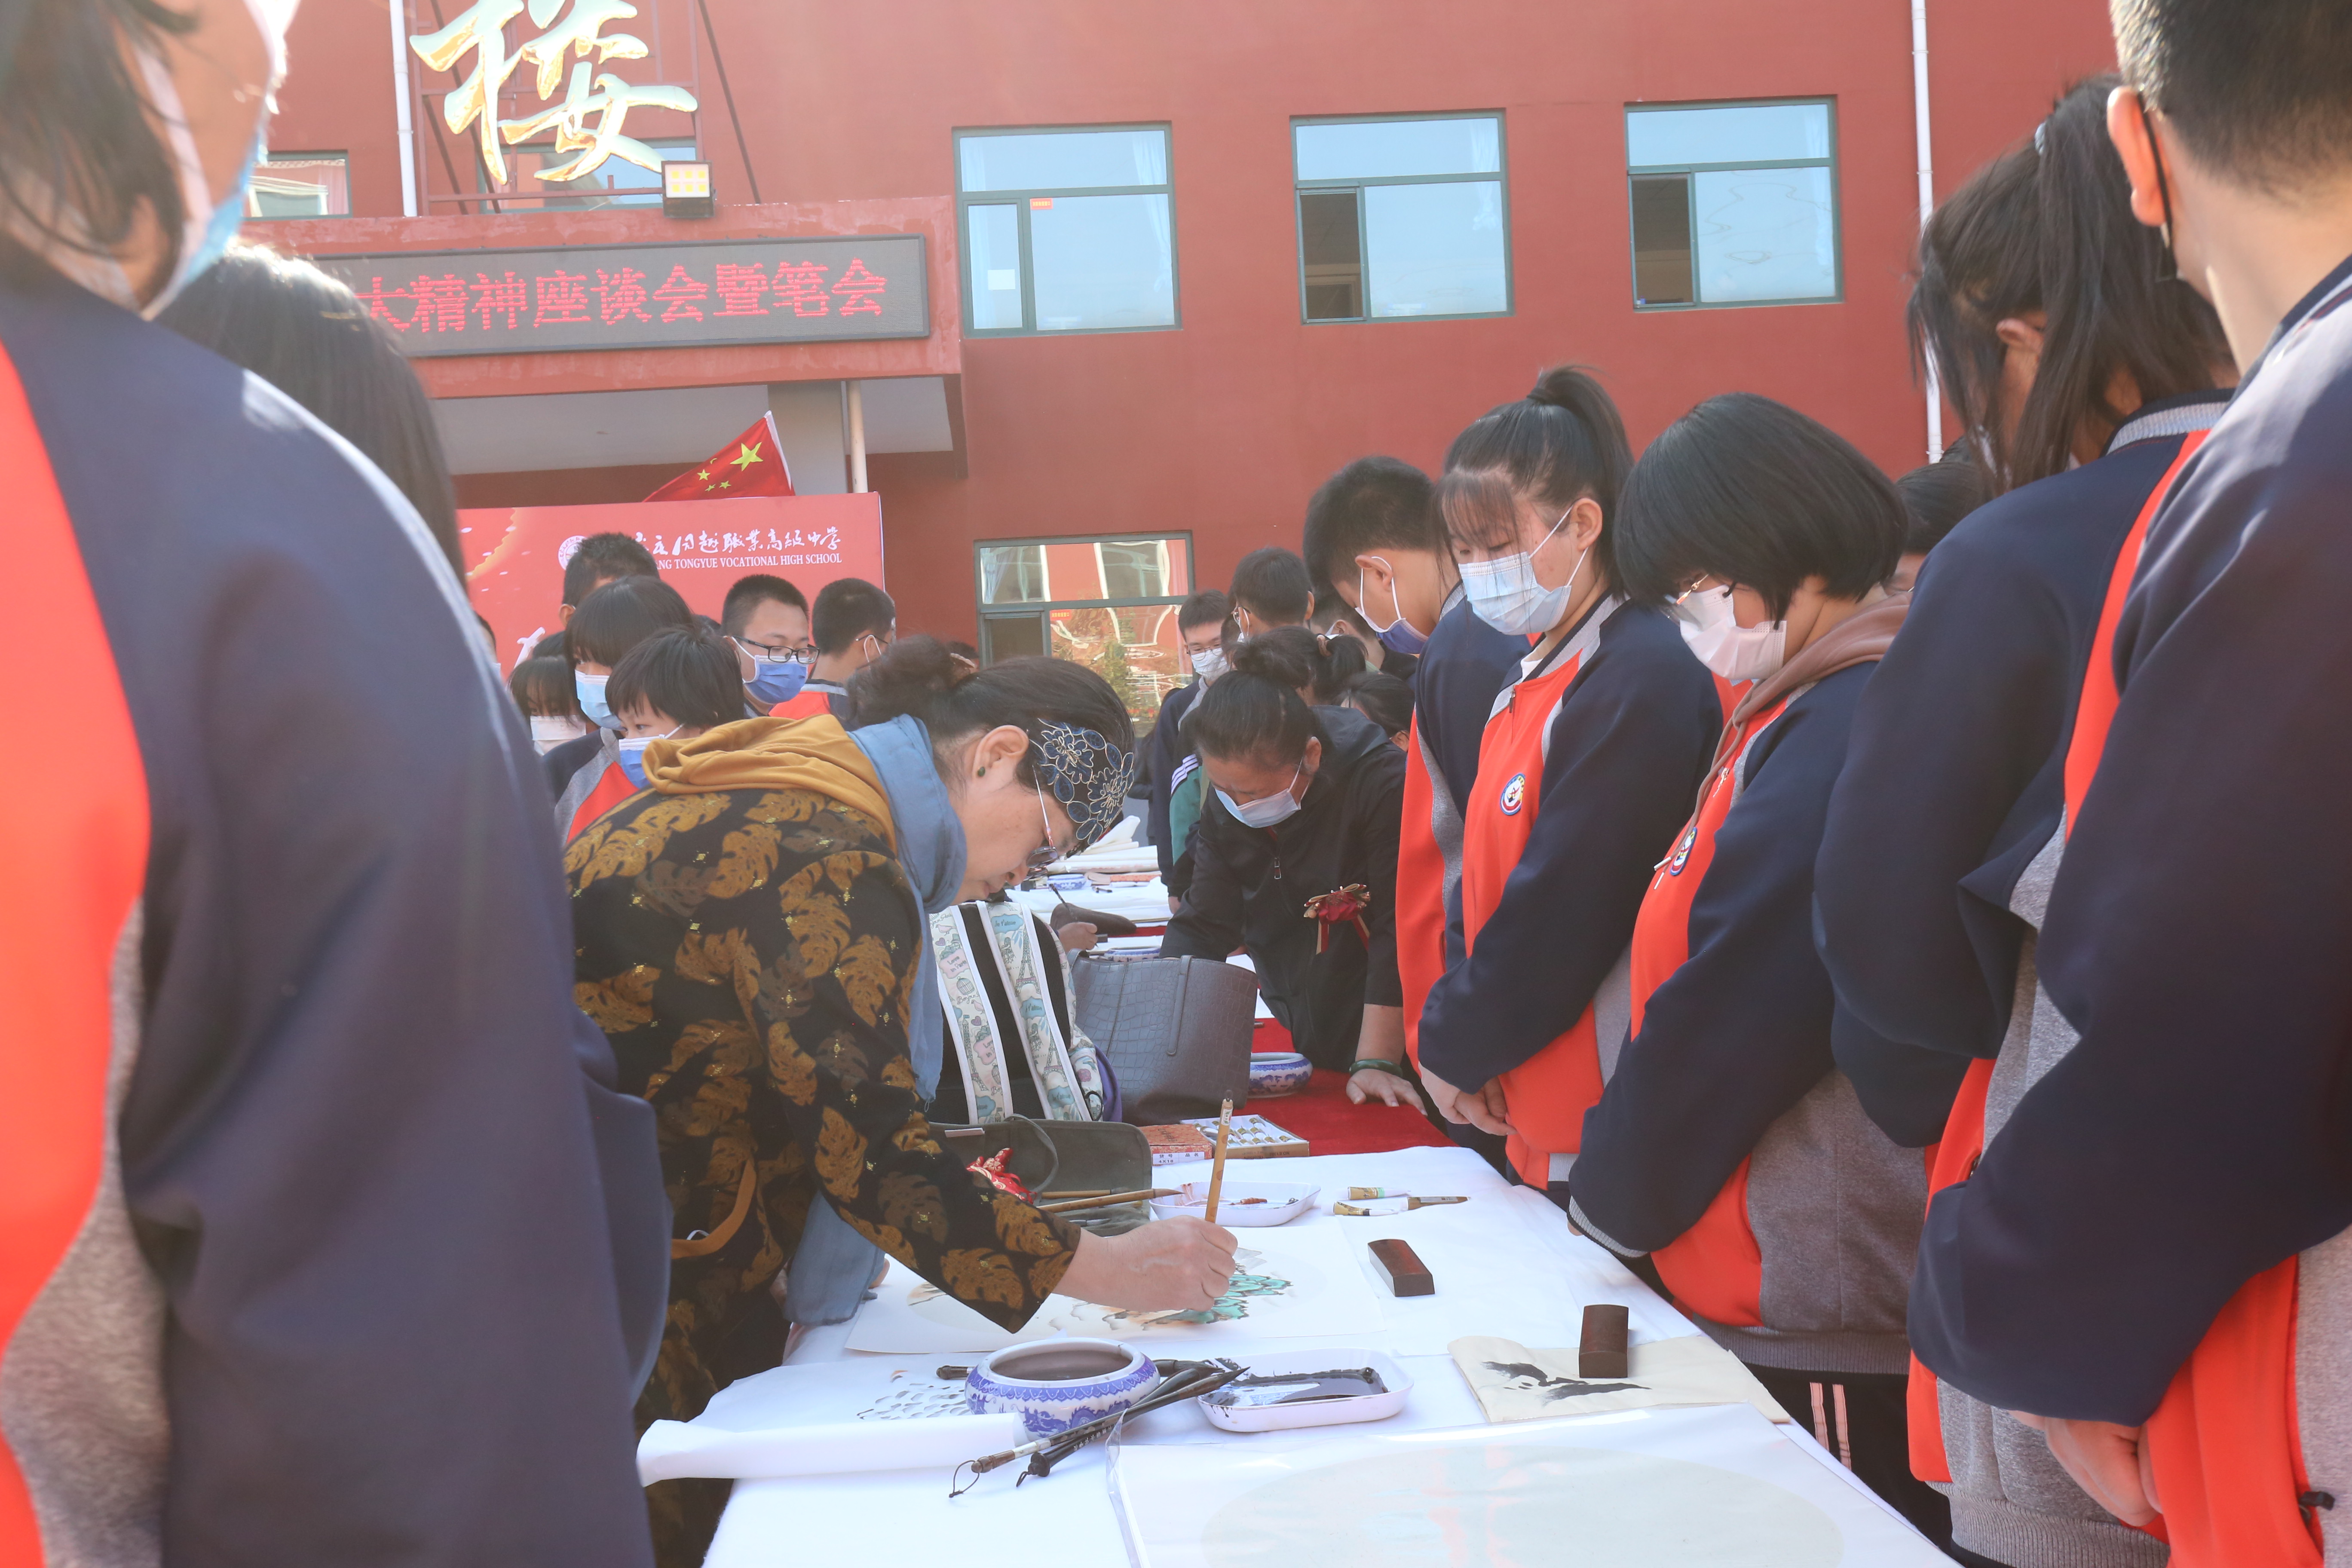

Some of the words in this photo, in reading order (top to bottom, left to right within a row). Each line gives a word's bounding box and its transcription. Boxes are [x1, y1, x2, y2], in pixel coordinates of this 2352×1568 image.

[409, 0, 698, 185] 楼
[674, 558, 718, 569] TONGYUE
[720, 556, 779, 567] VOCATIONAL
[780, 554, 803, 565] HIGH
[805, 553, 842, 564] SCHOOL
[947, 956, 960, 965] Love
